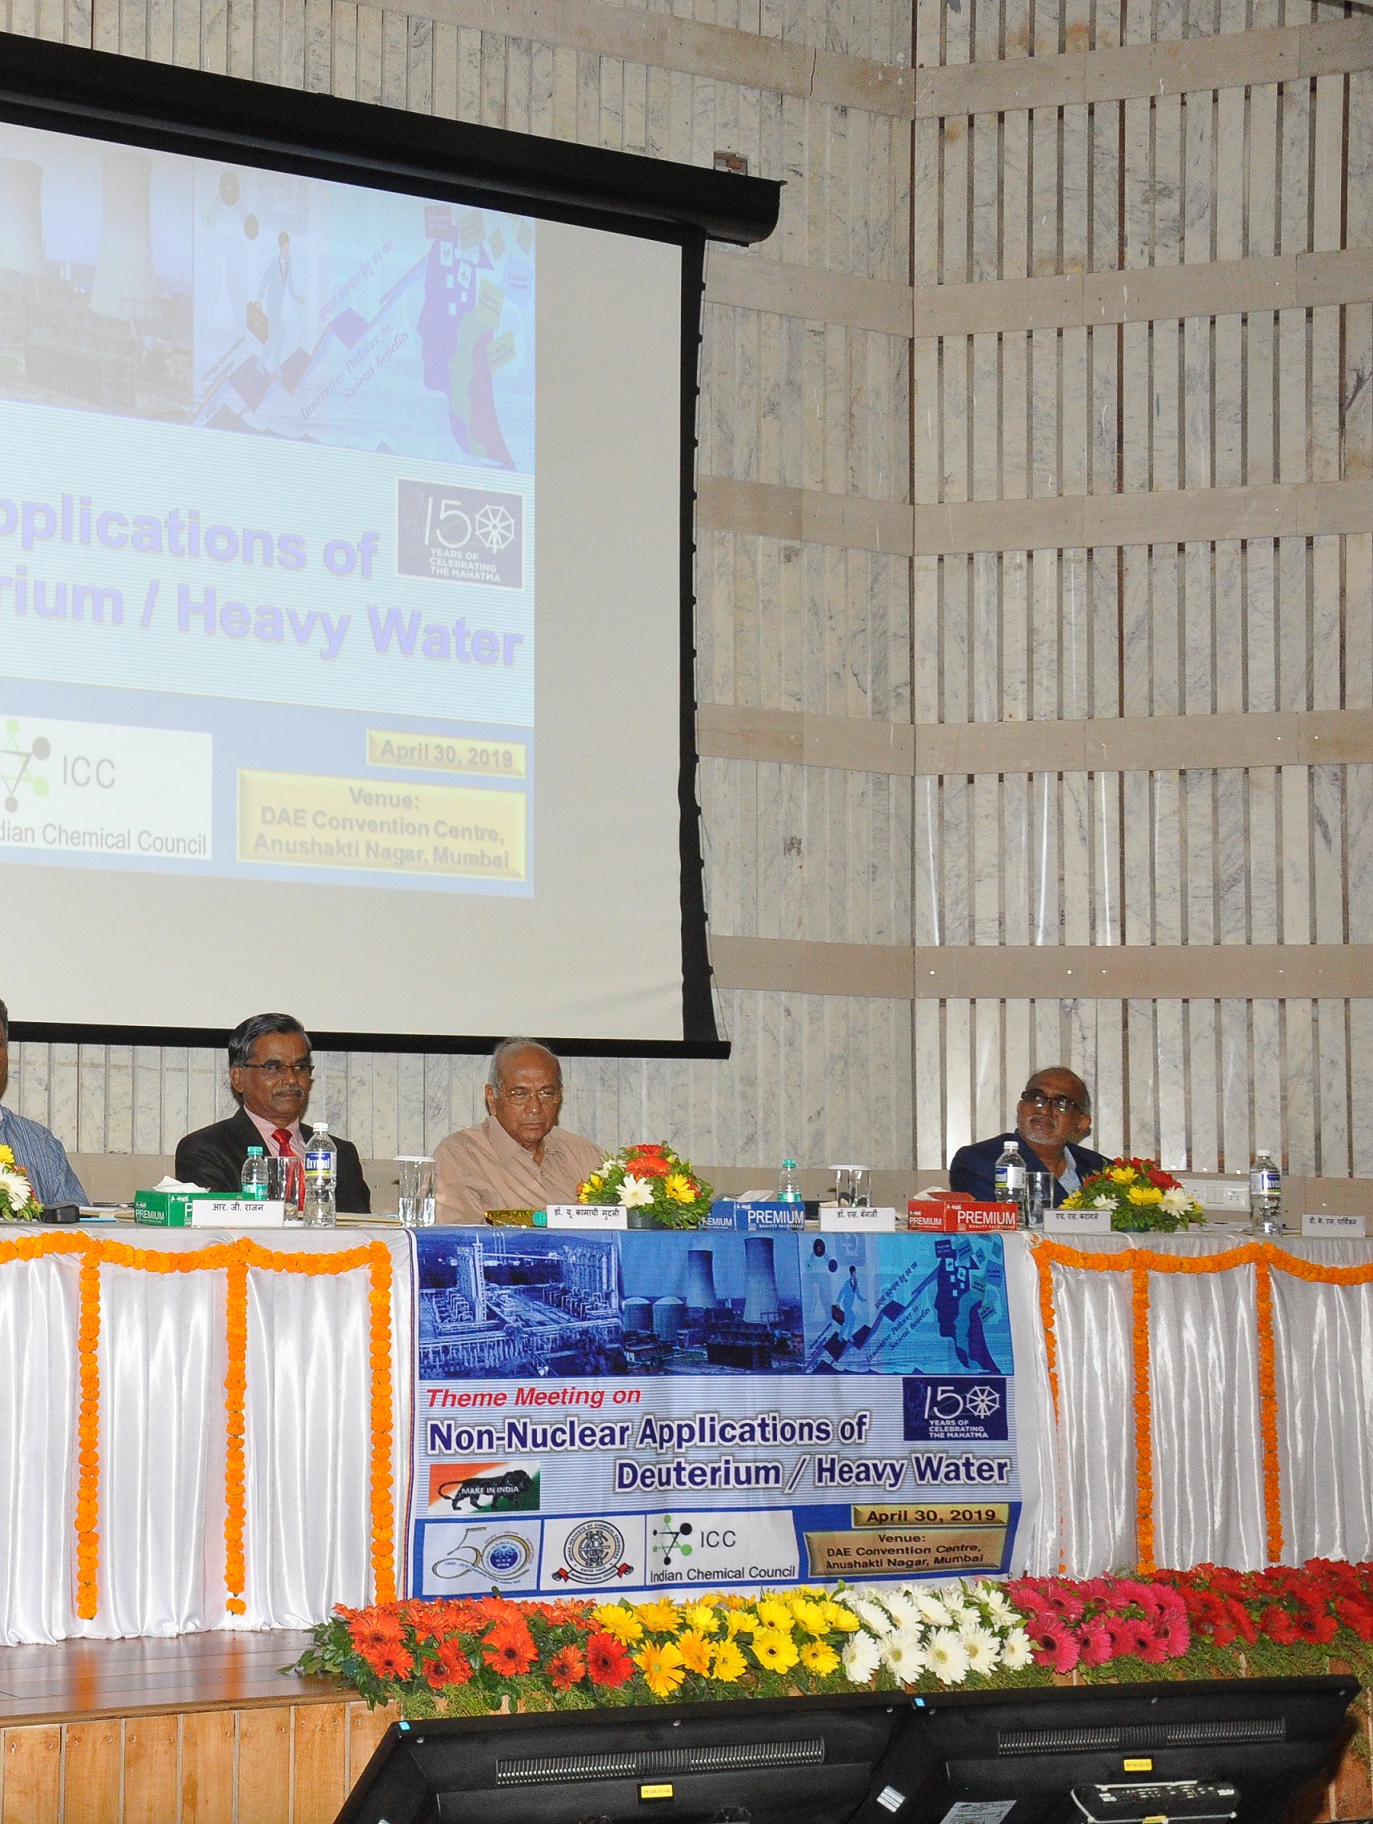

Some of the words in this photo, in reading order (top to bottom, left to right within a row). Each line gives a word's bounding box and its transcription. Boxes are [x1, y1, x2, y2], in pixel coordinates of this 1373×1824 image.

[323, 531, 378, 578] of
[431, 548, 463, 560] YEARS
[465, 552, 479, 560] OF
[430, 557, 496, 573] CELEBRATING
[431, 566, 449, 576] THE
[452, 569, 501, 582] MAHATMA
[178, 584, 351, 659] Heavy
[367, 605, 524, 666] Water
[380, 738, 427, 766] April
[433, 744, 462, 767] 30,
[467, 747, 512, 768] 2019
[62, 755, 116, 789] ICC
[349, 786, 419, 810] Venue:
[260, 806, 307, 828] DAE
[311, 810, 430, 837] Convention
[433, 821, 504, 847] Centre,
[41, 823, 131, 850] Chemical
[137, 829, 207, 855] Council
[253, 832, 360, 858] Anushakti
[364, 840, 427, 866] Nagar,
[432, 844, 508, 869] Mumbai
[136, 1209, 165, 1220] PREMIUM
[748, 1210, 803, 1224] PREMIUM
[909, 1216, 942, 1225] PREMIUM
[958, 1210, 1016, 1225] PREMIUM
[427, 1388, 507, 1408] Theme
[514, 1386, 605, 1408] Meeting
[612, 1389, 642, 1405] on
[428, 1418, 631, 1452] Non-Nuclear
[638, 1414, 832, 1451] Applications
[840, 1413, 869, 1442] of
[616, 1457, 781, 1490] Deuterium
[785, 1457, 810, 1492] /
[816, 1456, 906, 1489] Heavy
[913, 1454, 1009, 1484] Water
[461, 1486, 484, 1495] MAKE
[485, 1486, 495, 1494] IN
[496, 1486, 519, 1494] INDIA
[867, 1510, 907, 1525] April
[915, 1510, 944, 1523] 30,
[951, 1509, 996, 1521] 2019
[701, 1531, 736, 1547] ICC
[878, 1534, 925, 1543] Venue:
[827, 1547, 851, 1557] DAE
[856, 1546, 931, 1557] Convention
[936, 1544, 981, 1554] Centre,
[826, 1557, 883, 1569] Anushakti
[887, 1557, 929, 1568] Nagar,
[934, 1554, 983, 1564] Mumbai
[650, 1570, 682, 1583] Indian
[687, 1567, 745, 1580] Chemical
[749, 1565, 796, 1578] Council
